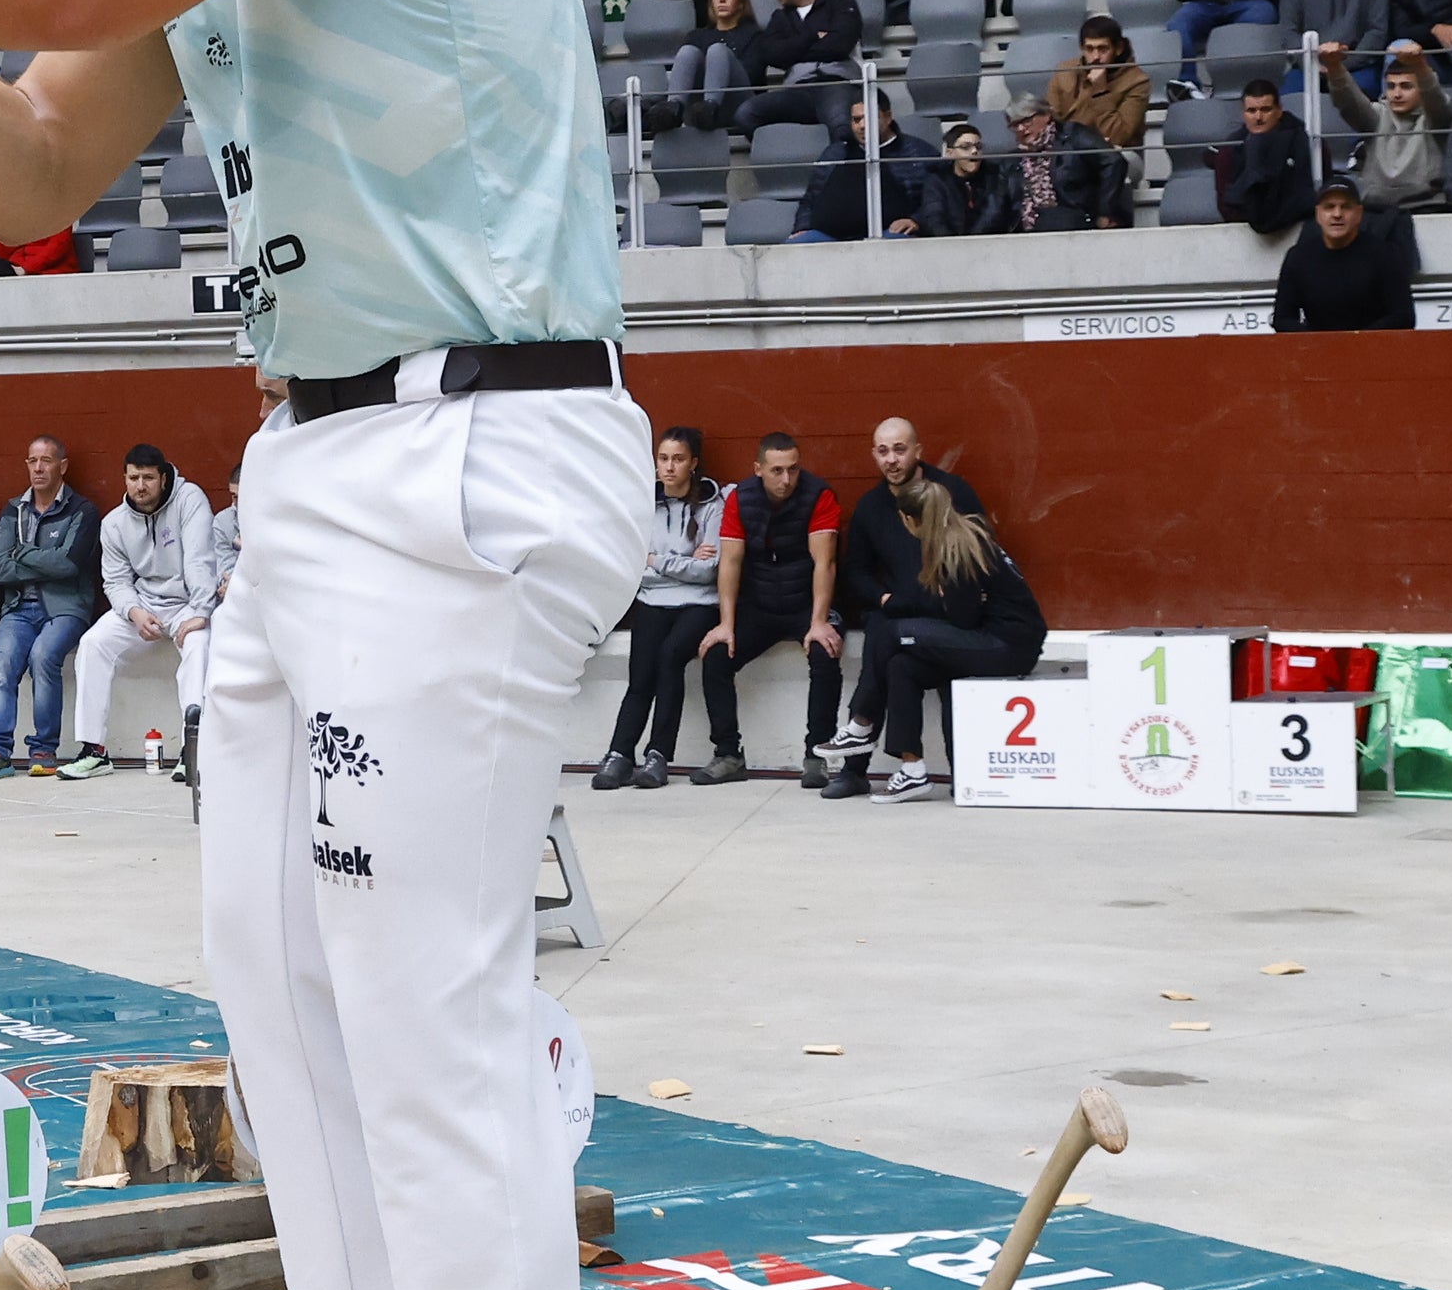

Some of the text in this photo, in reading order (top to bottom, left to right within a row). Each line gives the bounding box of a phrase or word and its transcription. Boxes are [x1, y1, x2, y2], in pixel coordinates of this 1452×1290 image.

[1059, 314, 1176, 337] SERVICIOS
[1139, 645, 1167, 706] 1
[1005, 695, 1037, 747] 2
[1280, 713, 1312, 762] 3
[987, 751, 1057, 765] EUSKADI
[1269, 766, 1325, 778] EUSKADI
